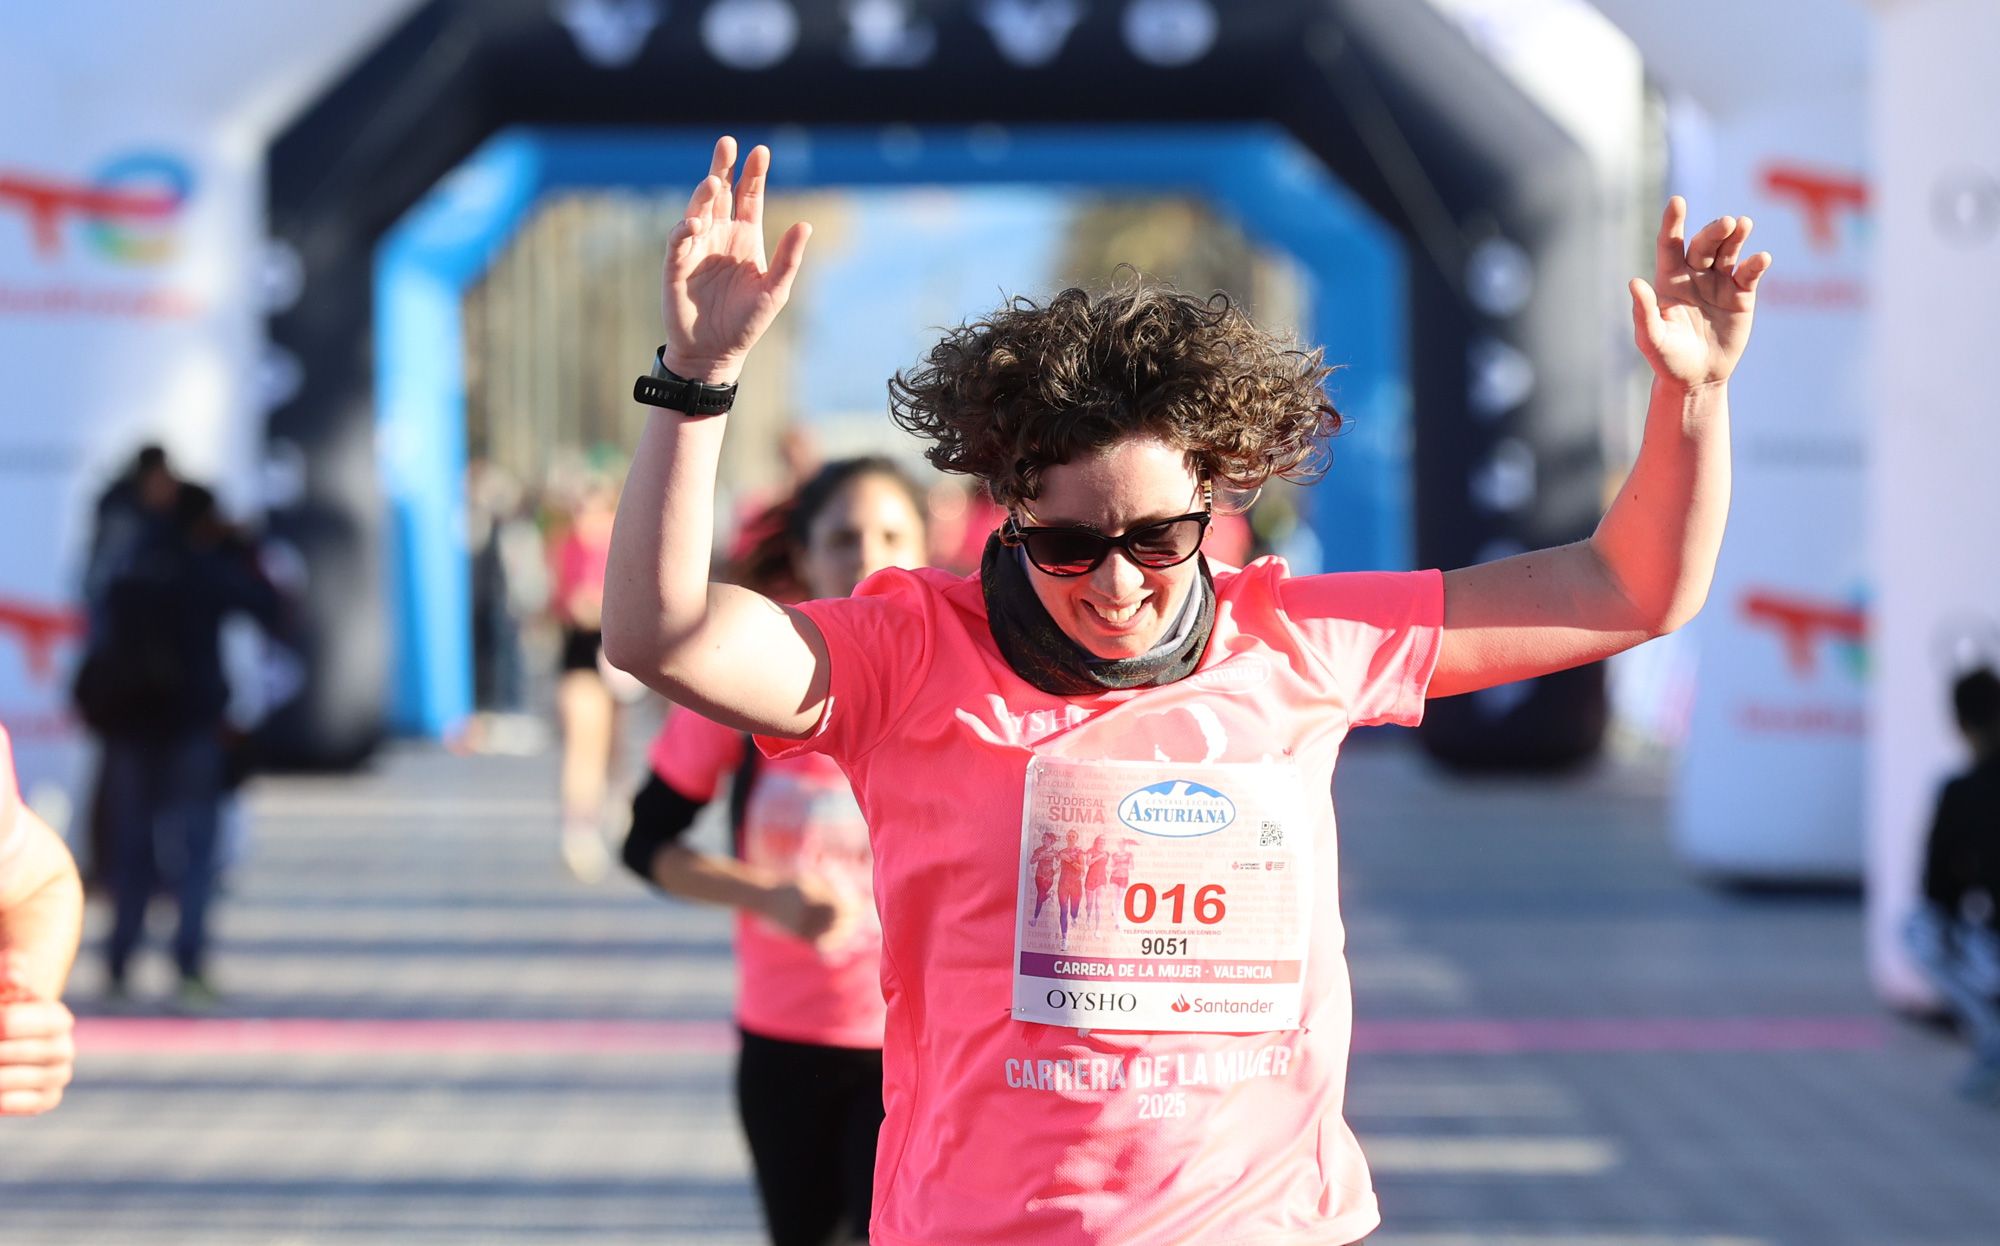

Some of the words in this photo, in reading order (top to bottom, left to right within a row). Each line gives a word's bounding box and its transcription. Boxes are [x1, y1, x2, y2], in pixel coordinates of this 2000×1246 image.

[553, 0, 1221, 70] VOLVO
[1047, 795, 1060, 806] TU
[1064, 797, 1105, 808] DORSAL
[1127, 799, 1226, 824] ASTURIANA
[1048, 806, 1105, 824] SUMA
[1123, 883, 1226, 925] 016
[1141, 937, 1188, 955] 9051
[1053, 960, 1115, 977] CARRERA
[1118, 963, 1136, 977] DE
[1138, 964, 1154, 977] LA
[1158, 964, 1202, 978] MUJER
[1213, 965, 1273, 979] VALENCIA
[1046, 989, 1137, 1012] OYSHO
[1193, 998, 1274, 1013] Santander
[1005, 1058, 1127, 1091] CARRERA
[1135, 1054, 1170, 1088] DE
[1177, 1053, 1208, 1085] LA
[1215, 1045, 1292, 1084] MUJER
[1138, 1092, 1186, 1119] 2025
